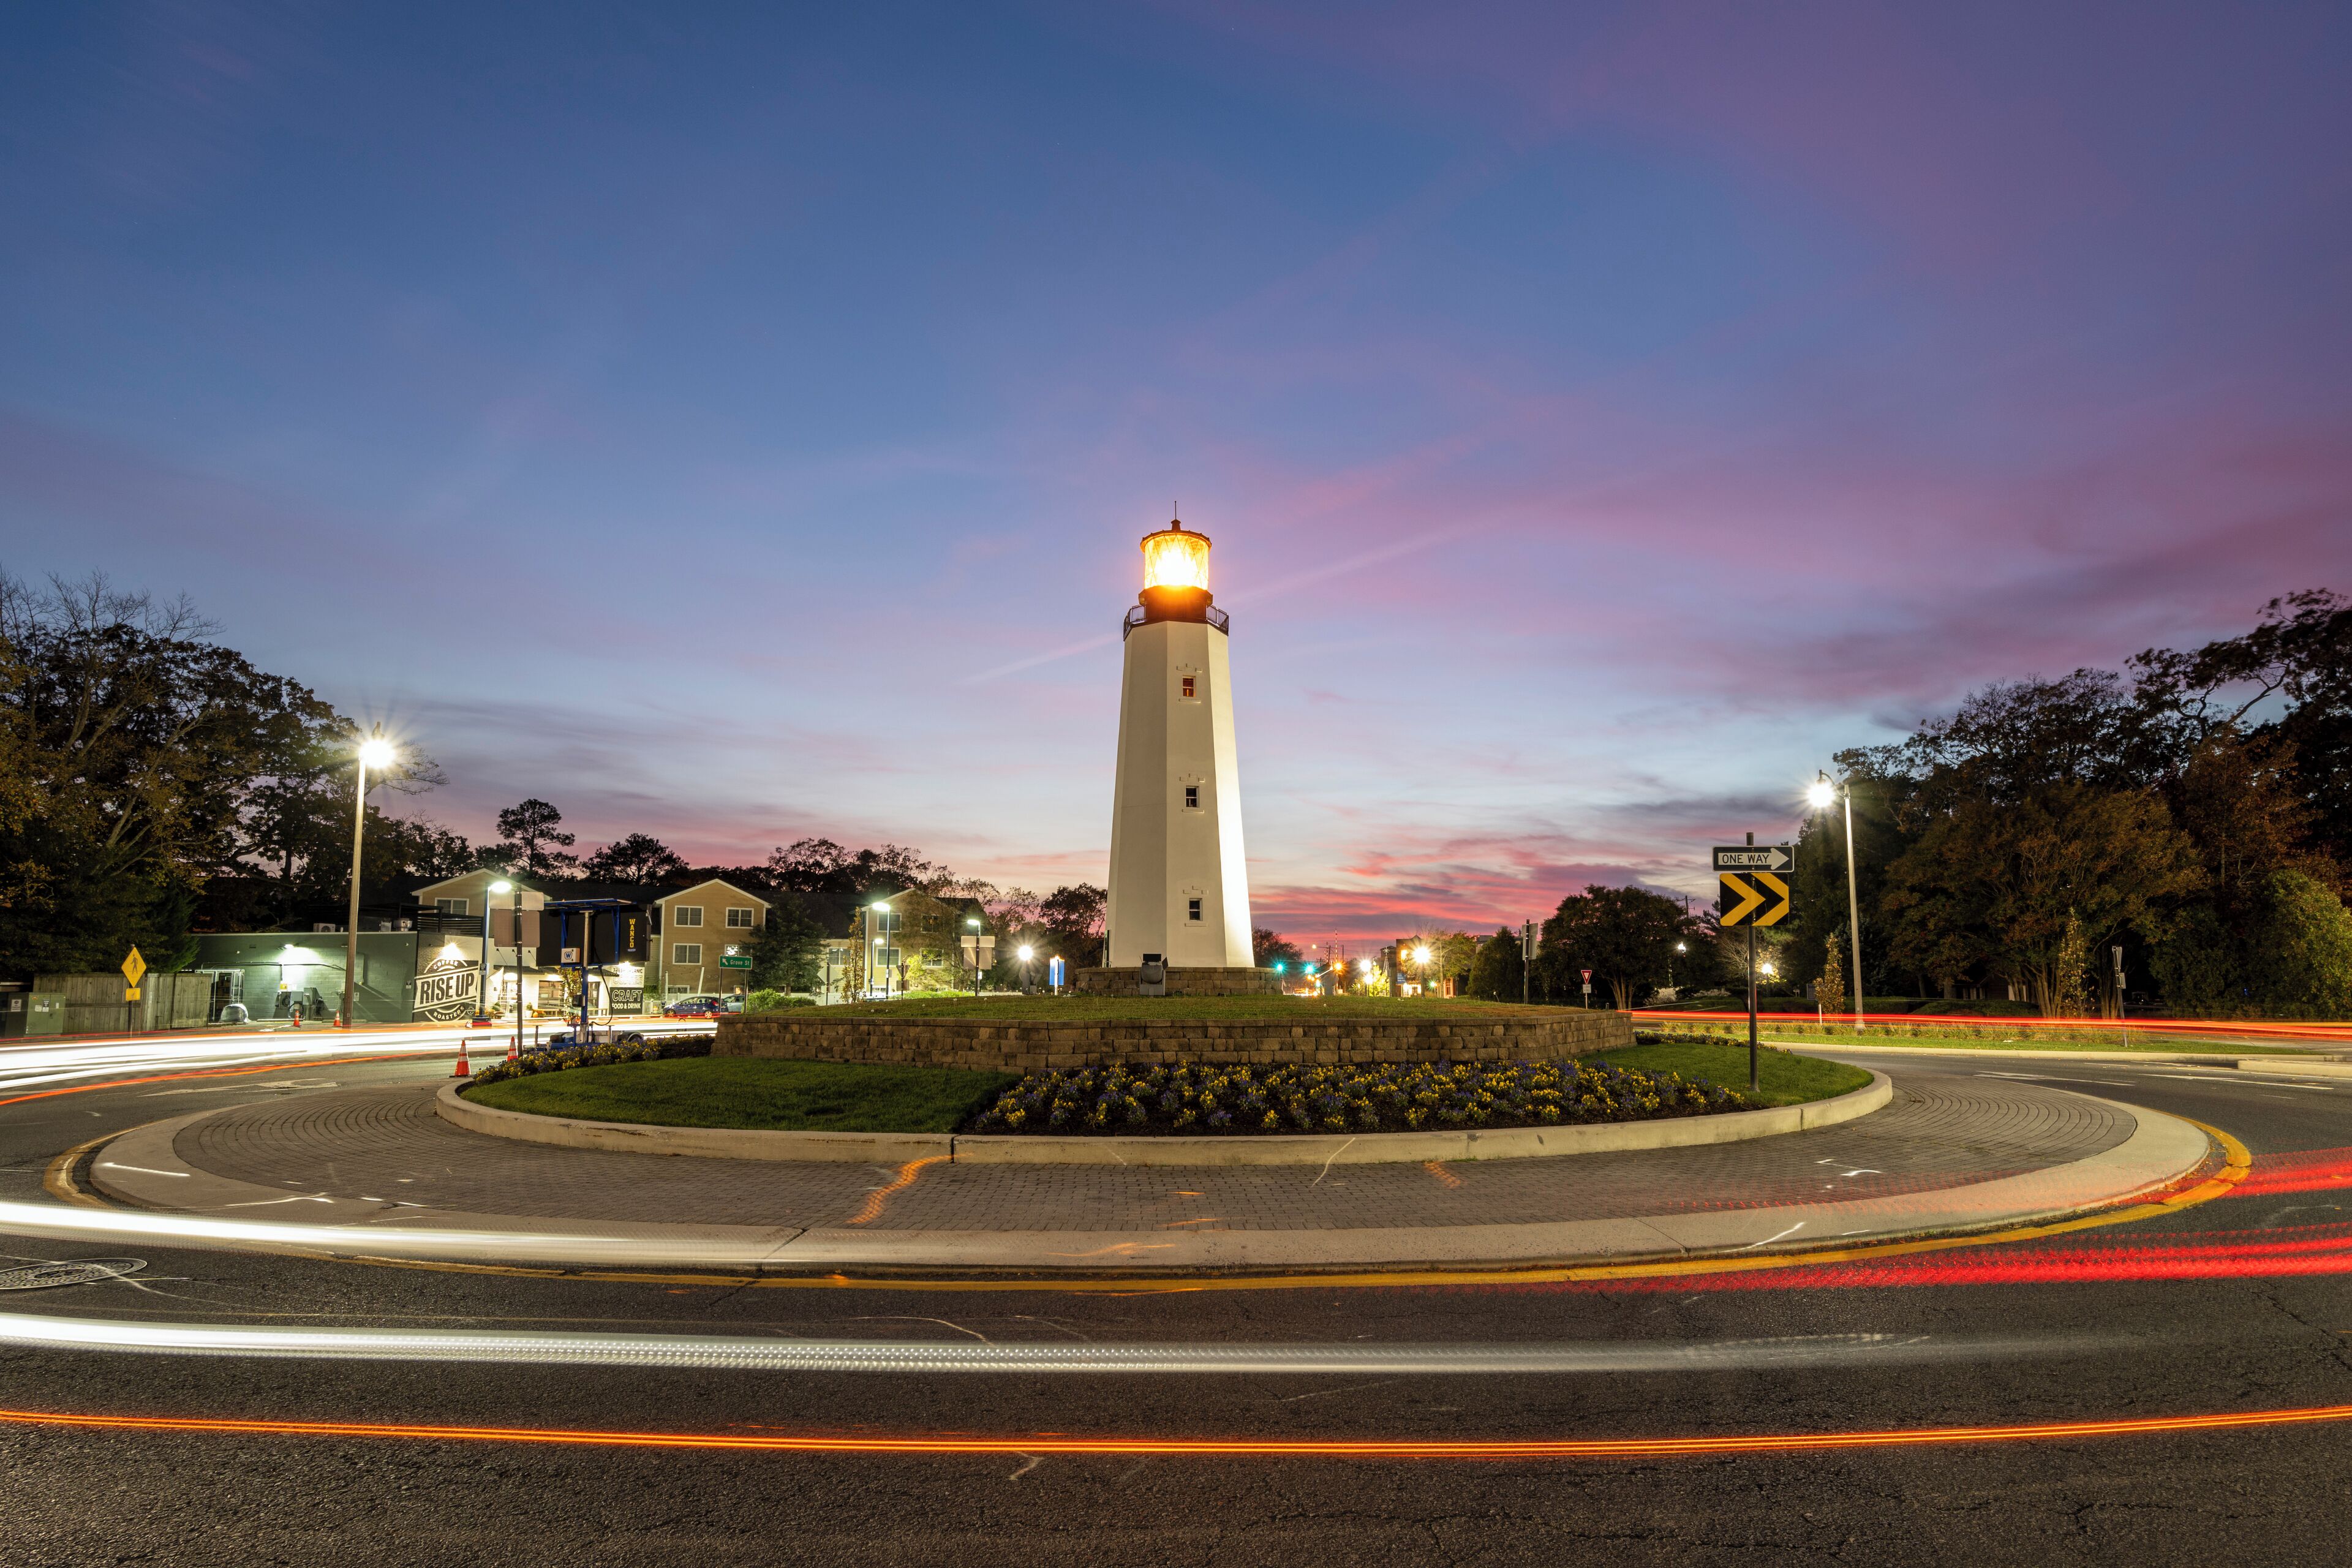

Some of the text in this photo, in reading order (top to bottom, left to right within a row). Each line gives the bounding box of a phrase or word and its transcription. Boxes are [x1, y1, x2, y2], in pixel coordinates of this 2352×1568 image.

[1722, 854, 1770, 864] ONE WAY
[434, 960, 459, 969] COFFEE
[613, 974, 643, 985] COEE
[420, 973, 475, 1005] RISE UP
[612, 989, 642, 1001] CRAFT
[433, 1006, 464, 1020] ROASTERS
